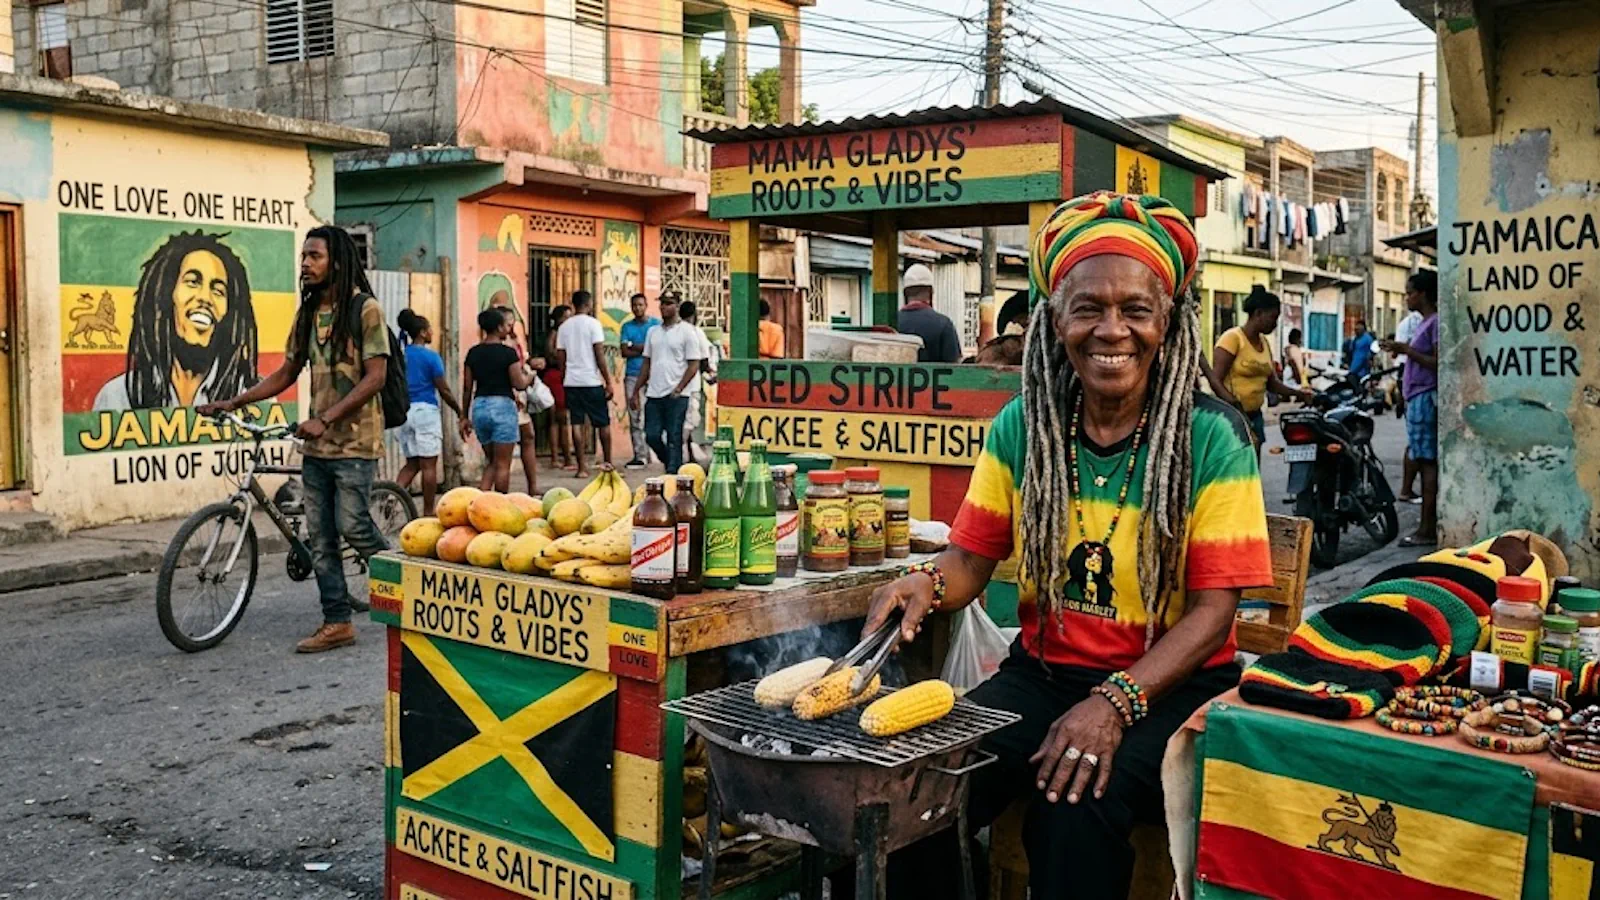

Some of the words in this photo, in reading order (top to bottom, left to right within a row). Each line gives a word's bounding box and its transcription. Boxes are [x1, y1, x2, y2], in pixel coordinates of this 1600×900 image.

[748, 138, 834, 174] MAMA
[57, 180, 104, 211] ONE
[114, 185, 177, 219] LOVE,
[183, 192, 224, 220] ONE
[232, 196, 299, 229] HEART,
[751, 176, 836, 213] ROOTS
[844, 177, 865, 205] &
[874, 167, 963, 205] VIBES
[1448, 213, 1600, 256] JAMAICA
[1468, 264, 1539, 292] LAND
[1549, 262, 1584, 289] OF
[1467, 303, 1553, 334] WOOD
[1563, 302, 1586, 332] &
[1474, 346, 1581, 378] WATER
[747, 363, 812, 404] RED
[829, 365, 953, 410] STRIPE
[740, 415, 823, 449] ACKEE
[835, 418, 850, 450] &
[860, 420, 985, 458] SALTFISH
[113, 454, 167, 485] LION
[175, 452, 202, 480] OF
[420, 569, 484, 607] MAMA
[413, 599, 480, 640] ROOTS
[491, 615, 507, 645] &
[517, 619, 589, 663] VIBES
[623, 632, 647, 647] ONE
[619, 652, 649, 669] LOVE
[404, 815, 470, 869] ACKEE
[476, 842, 489, 872] &
[495, 846, 613, 900] SALTFISH
